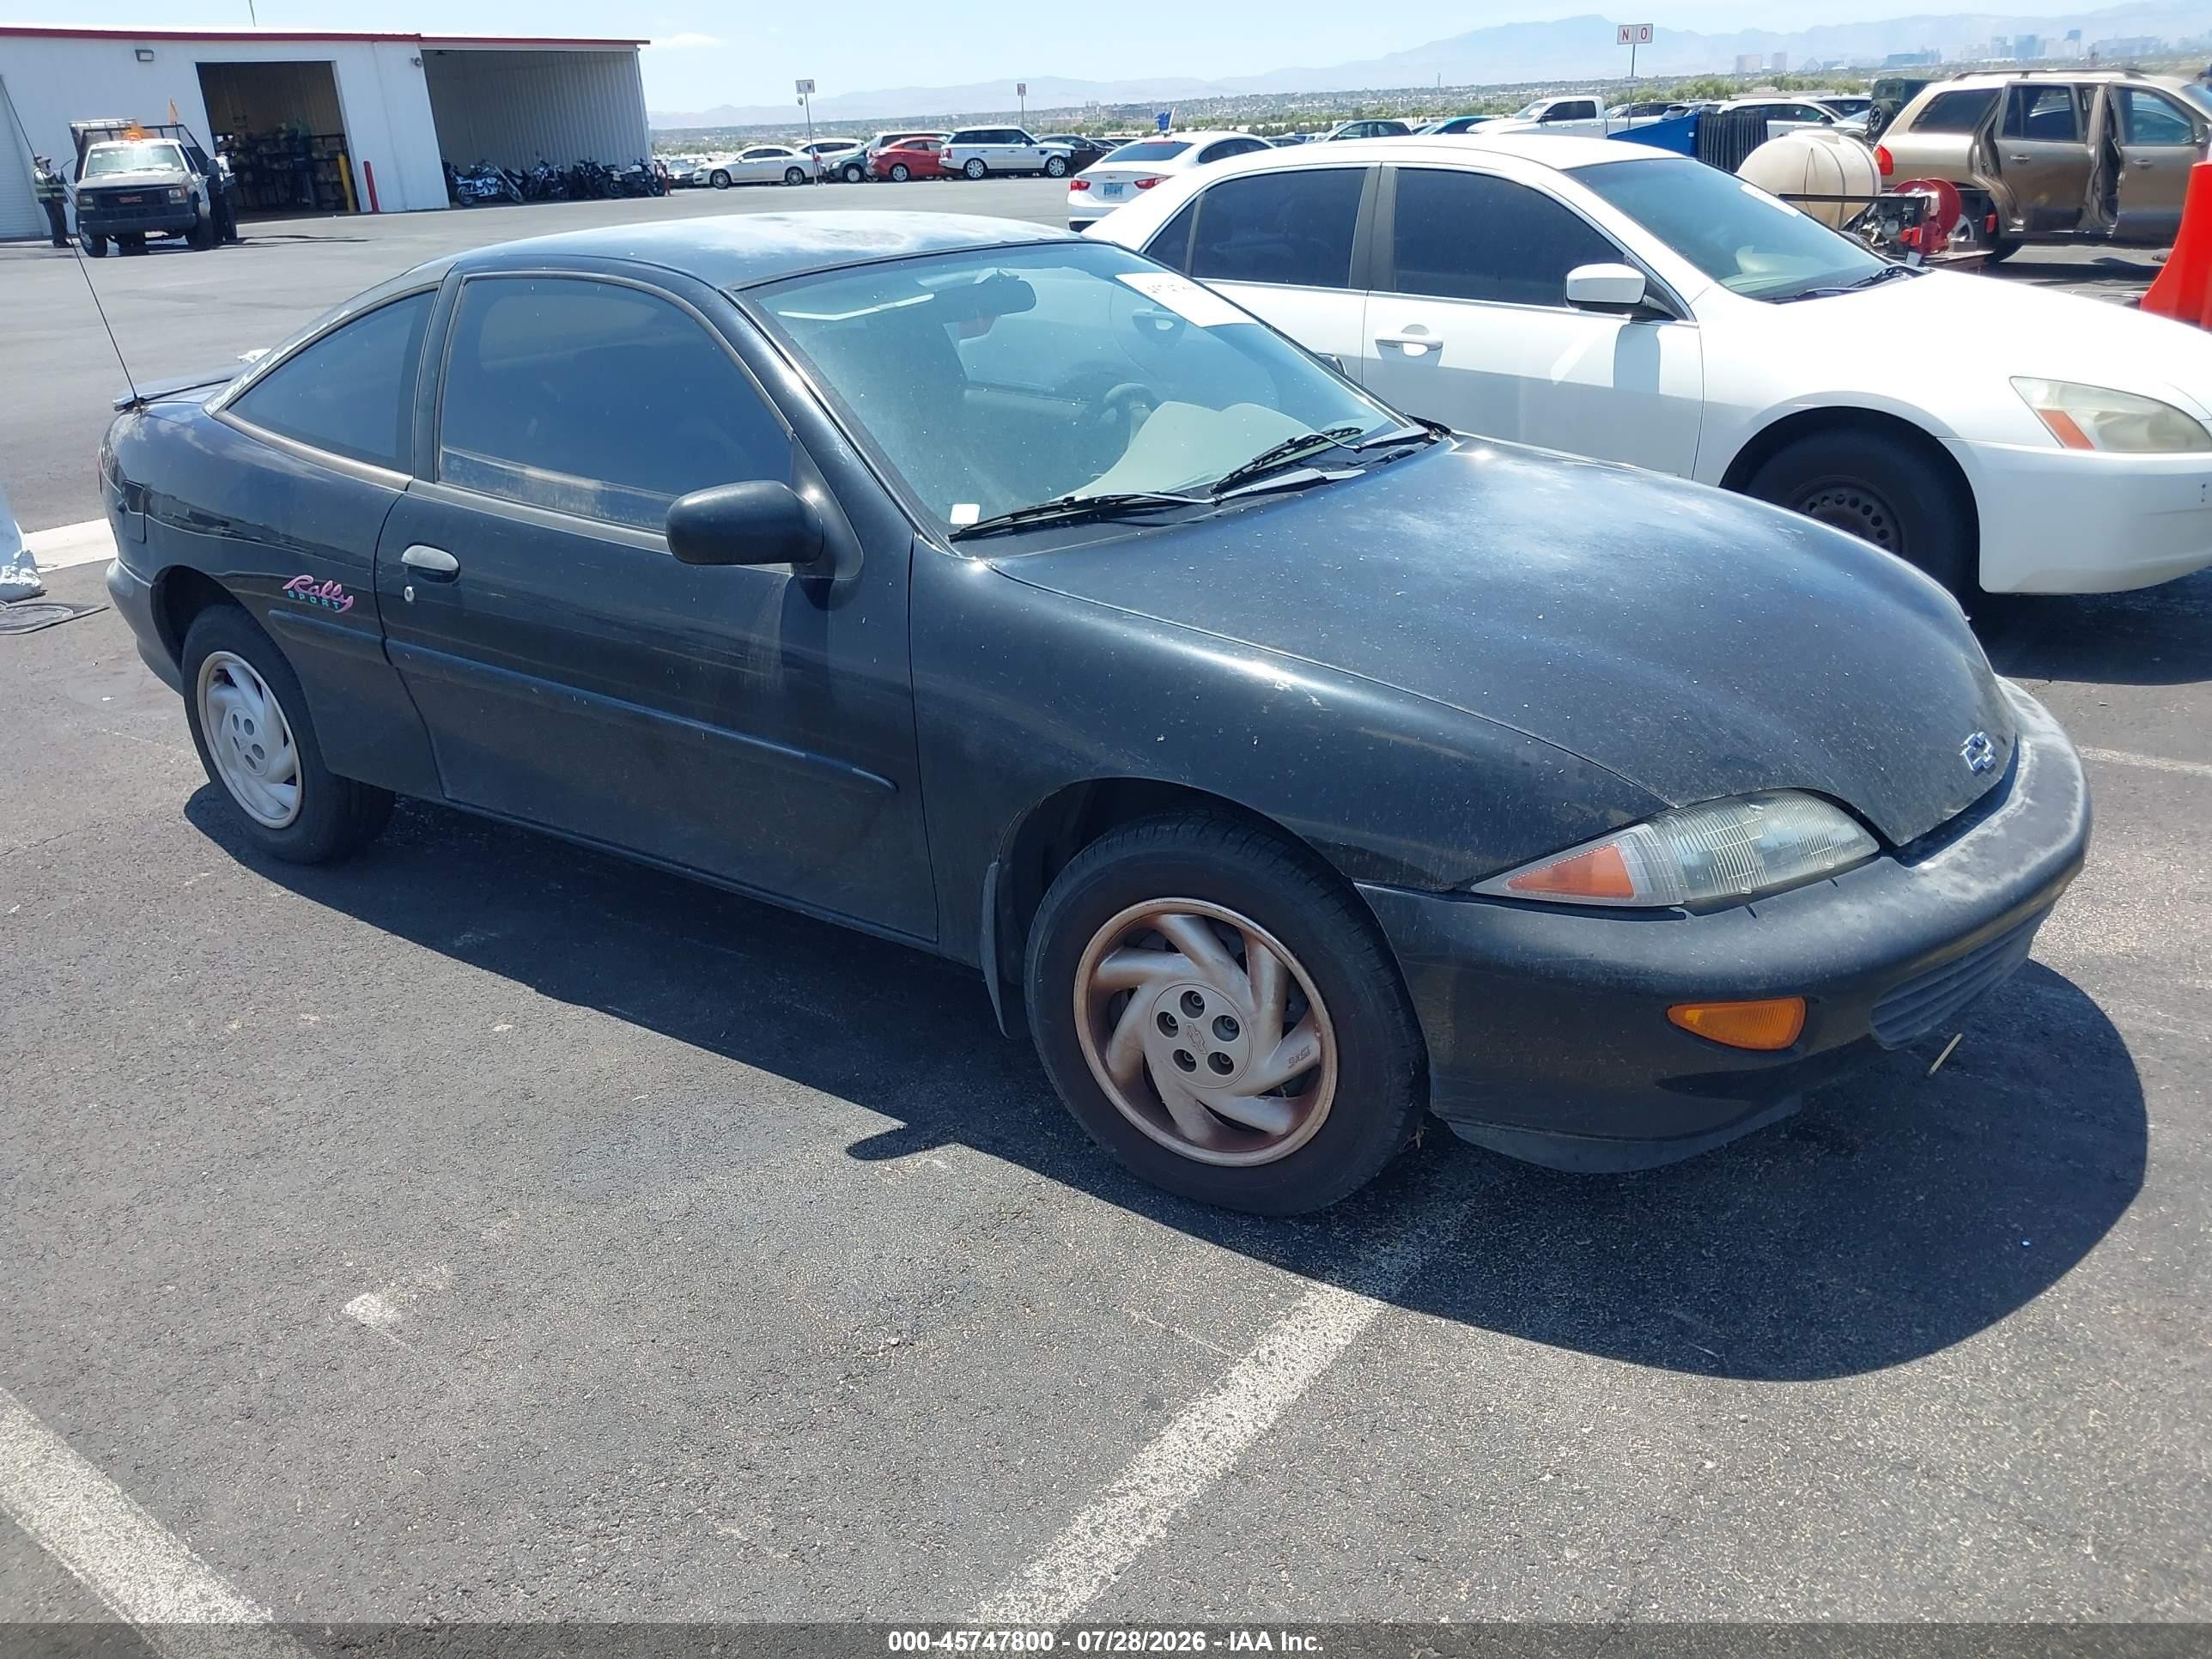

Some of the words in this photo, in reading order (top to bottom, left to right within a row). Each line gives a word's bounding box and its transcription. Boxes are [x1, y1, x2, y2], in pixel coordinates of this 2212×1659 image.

[1622, 28, 1630, 40] N
[282, 574, 354, 613] Rally
[288, 589, 339, 610] SPORT
